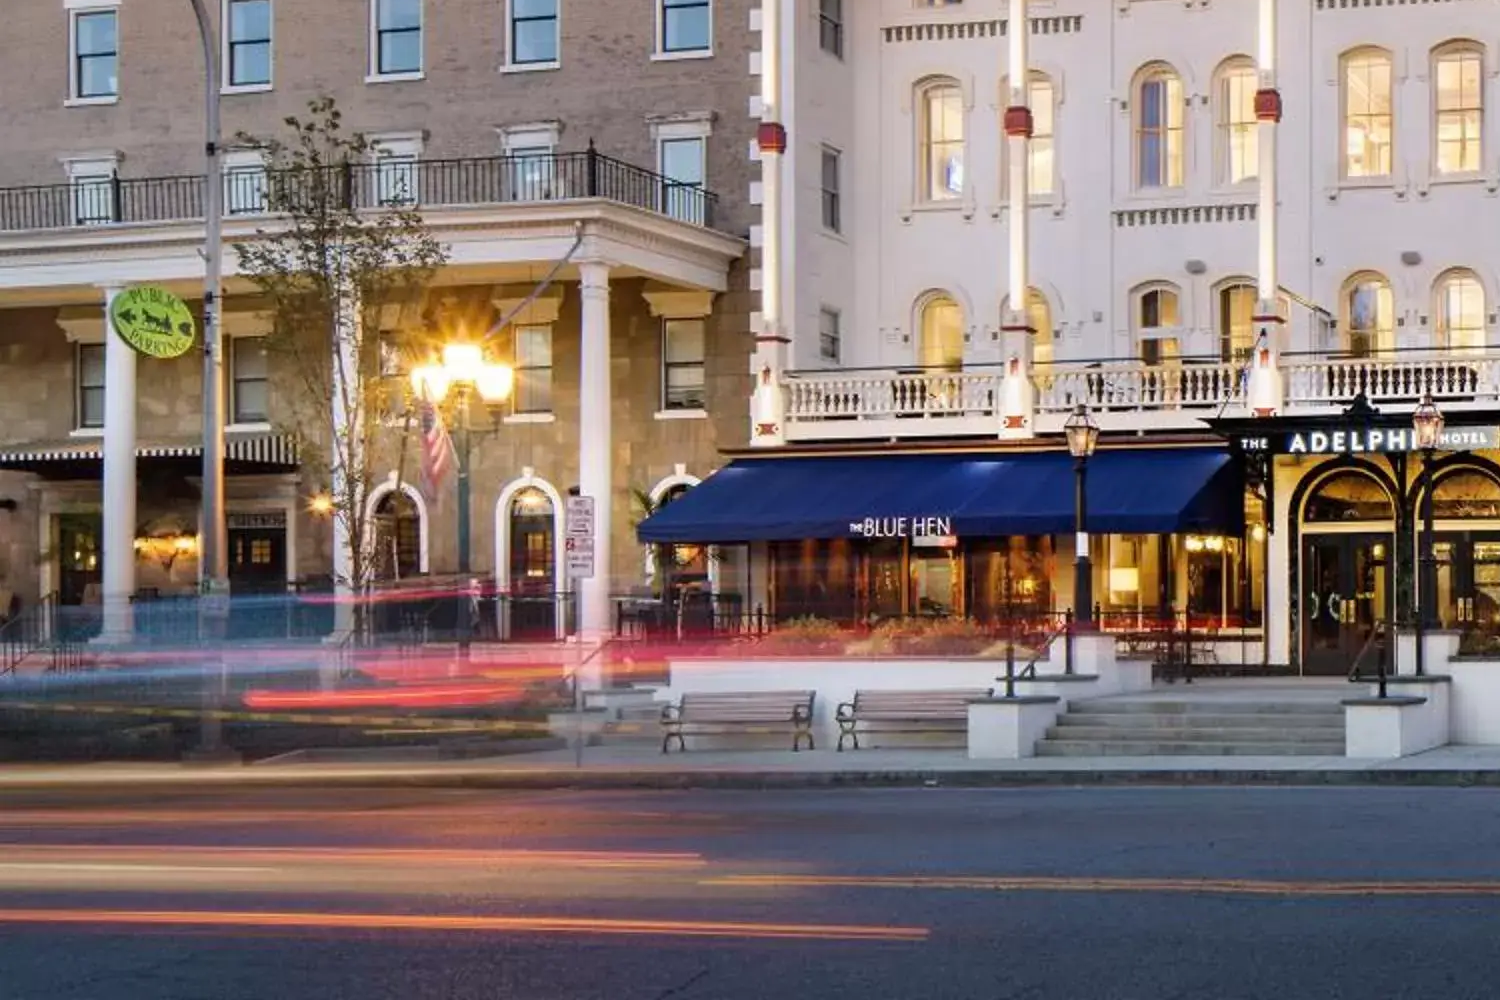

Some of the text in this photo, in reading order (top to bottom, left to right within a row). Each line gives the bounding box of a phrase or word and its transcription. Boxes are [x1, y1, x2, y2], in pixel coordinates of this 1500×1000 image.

[128, 286, 180, 314] PUBLIC
[128, 328, 190, 356] PARKING
[1240, 437, 1269, 450] THE
[1438, 430, 1489, 446] HOTEL
[863, 517, 907, 537] BLUE
[912, 516, 951, 537] HEN
